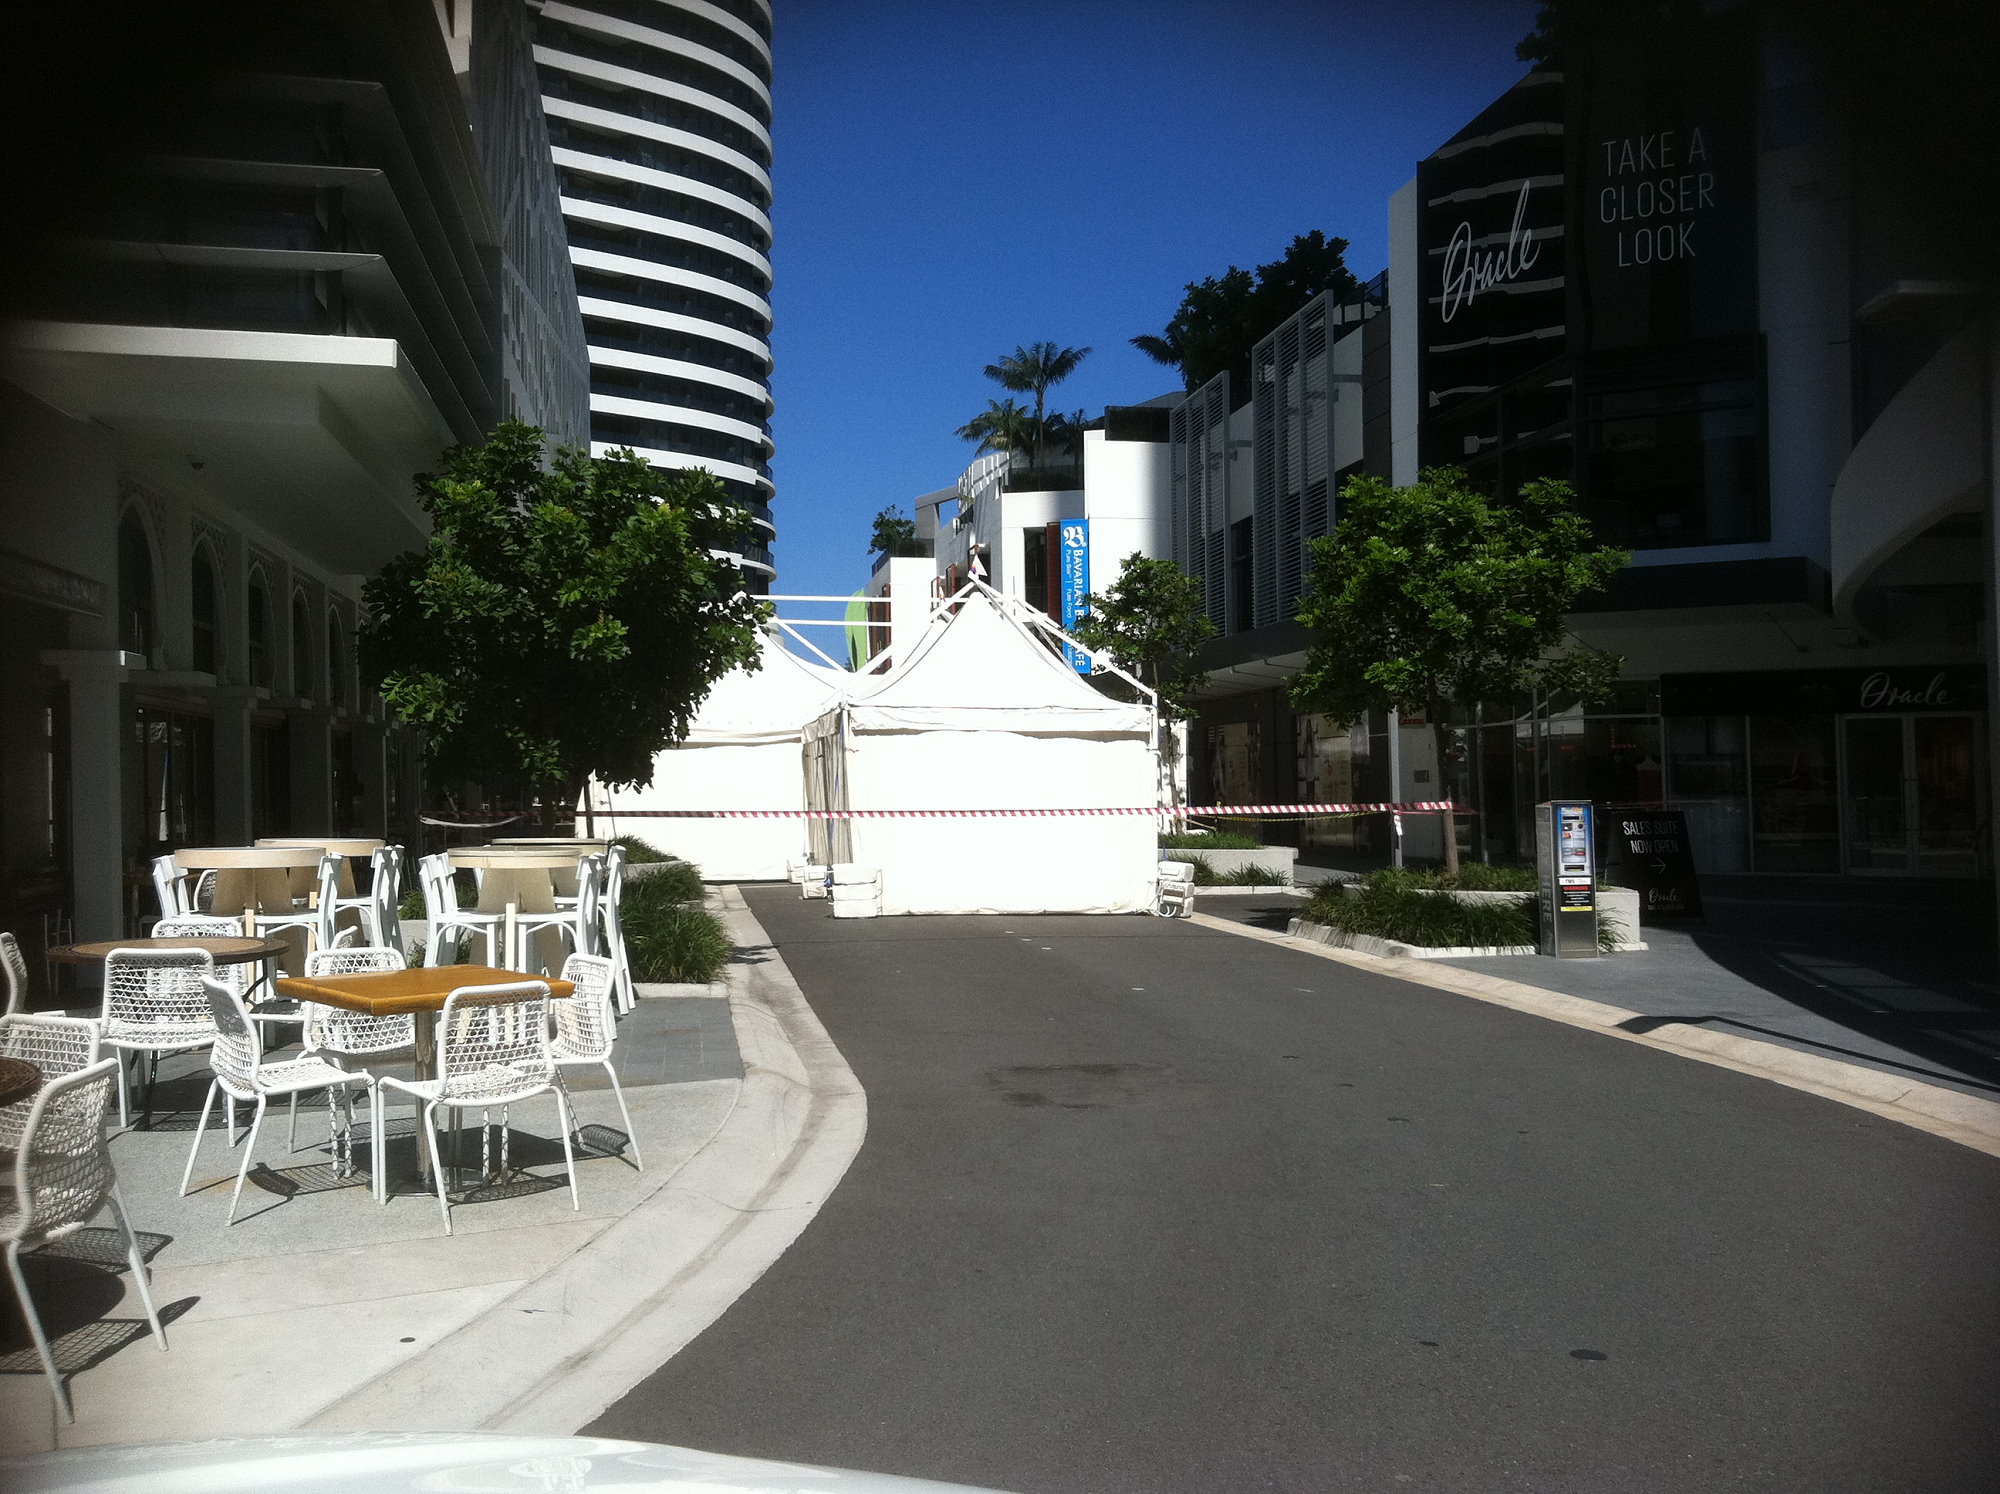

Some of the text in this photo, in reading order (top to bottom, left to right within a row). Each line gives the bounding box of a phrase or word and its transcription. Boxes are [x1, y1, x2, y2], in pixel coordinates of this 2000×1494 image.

[1601, 127, 1706, 177] TAKE A
[1600, 172, 1715, 223] CLOSER
[1442, 179, 1542, 323] Oracle
[1618, 220, 1696, 268] LOOK
[1073, 549, 1084, 606] BAVARIAN
[1860, 671, 1952, 708] Oracle
[1622, 820, 1679, 836] SALES SUITE
[1630, 839, 1679, 854] NOW OPEN
[1541, 874, 1552, 923] HERE
